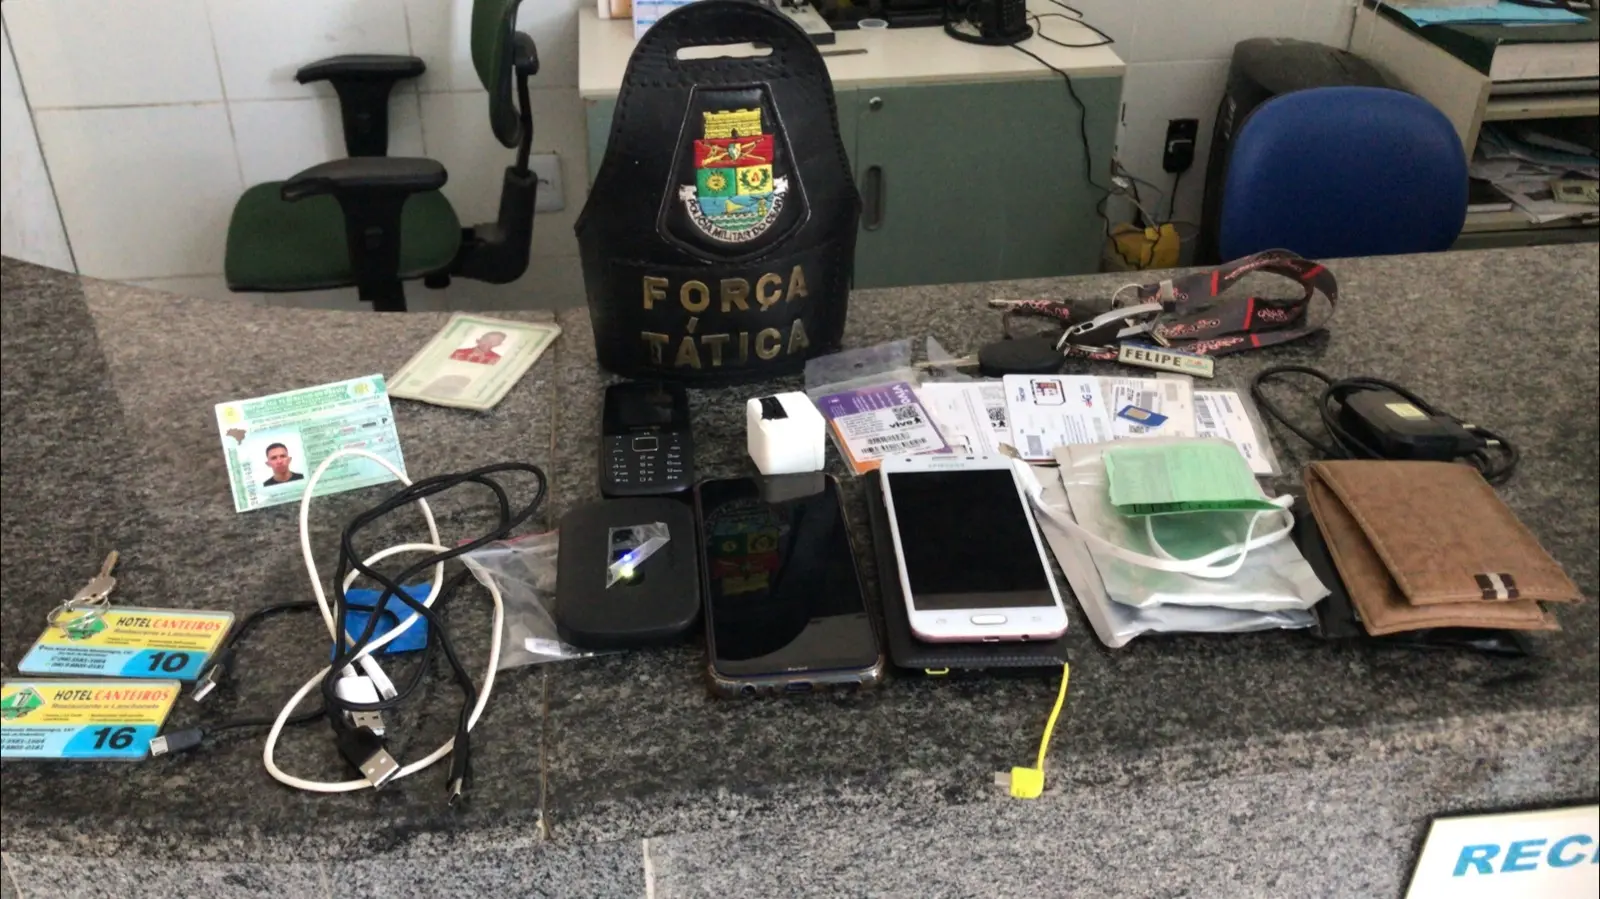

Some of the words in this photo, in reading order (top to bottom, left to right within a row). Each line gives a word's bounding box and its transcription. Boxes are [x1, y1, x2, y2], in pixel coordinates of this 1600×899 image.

[712, 228, 751, 241] MILITAR
[642, 263, 809, 313] FORÇA
[640, 316, 810, 369] TÁTICA
[1124, 348, 1182, 368] FELIPE
[888, 418, 909, 429] vivo
[116, 616, 151, 628] HOTEL
[152, 618, 222, 632] CANTEIROS
[148, 651, 189, 673] 10
[53, 689, 93, 702] HOTEL
[94, 689, 171, 701] CANTEIROS
[93, 726, 137, 751] 16
[1452, 834, 1598, 877] REC
